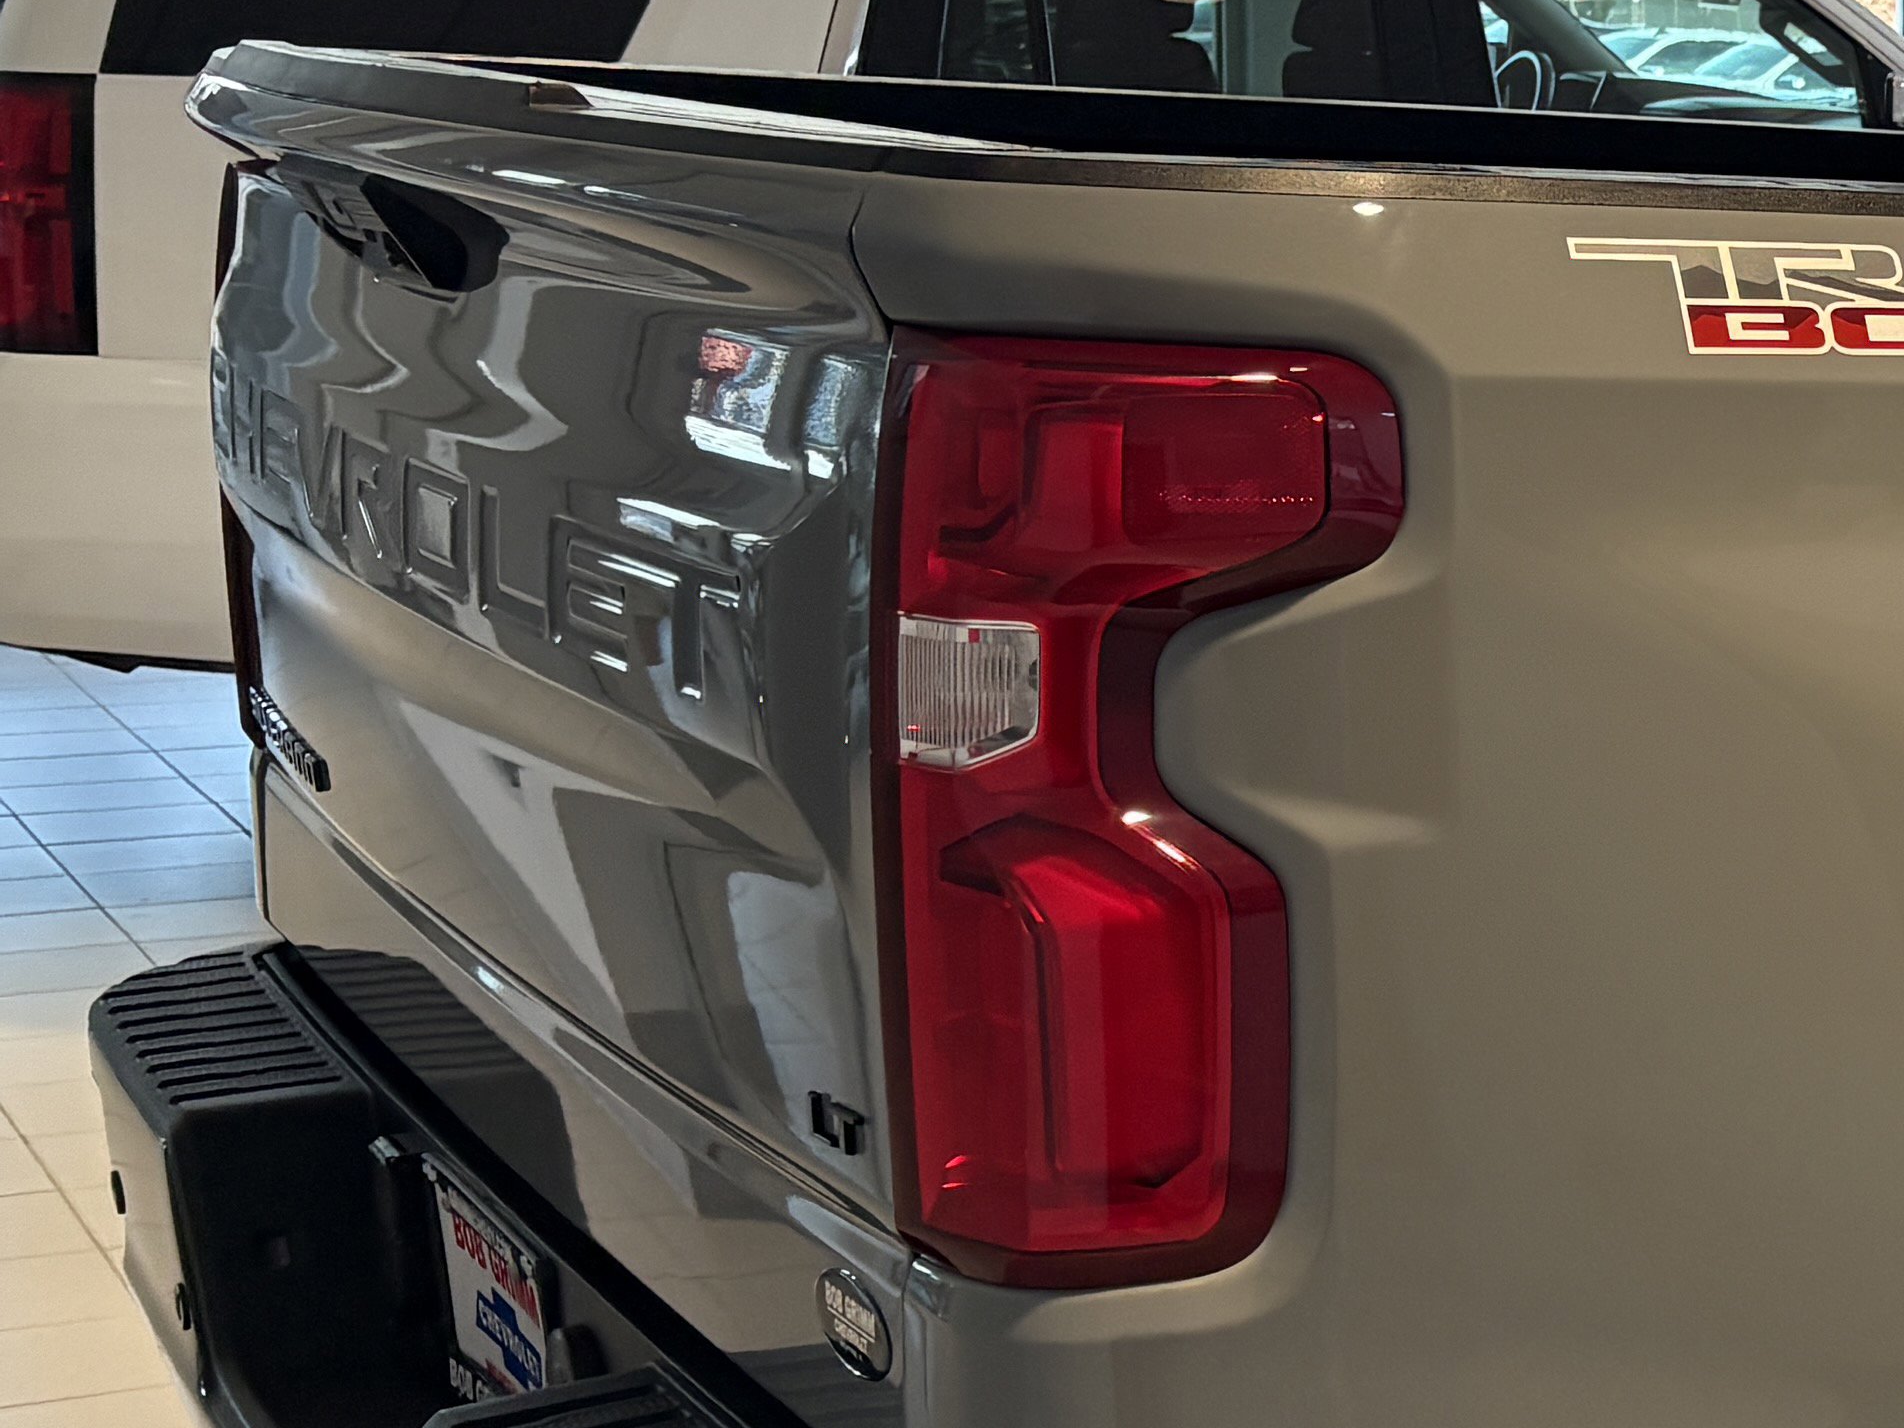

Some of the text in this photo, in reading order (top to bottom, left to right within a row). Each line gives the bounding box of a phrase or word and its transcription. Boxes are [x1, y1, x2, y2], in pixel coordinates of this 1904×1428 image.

[211, 352, 741, 700] CHEVROLET
[807, 1090, 868, 1156] LT
[452, 1213, 487, 1270] BOB
